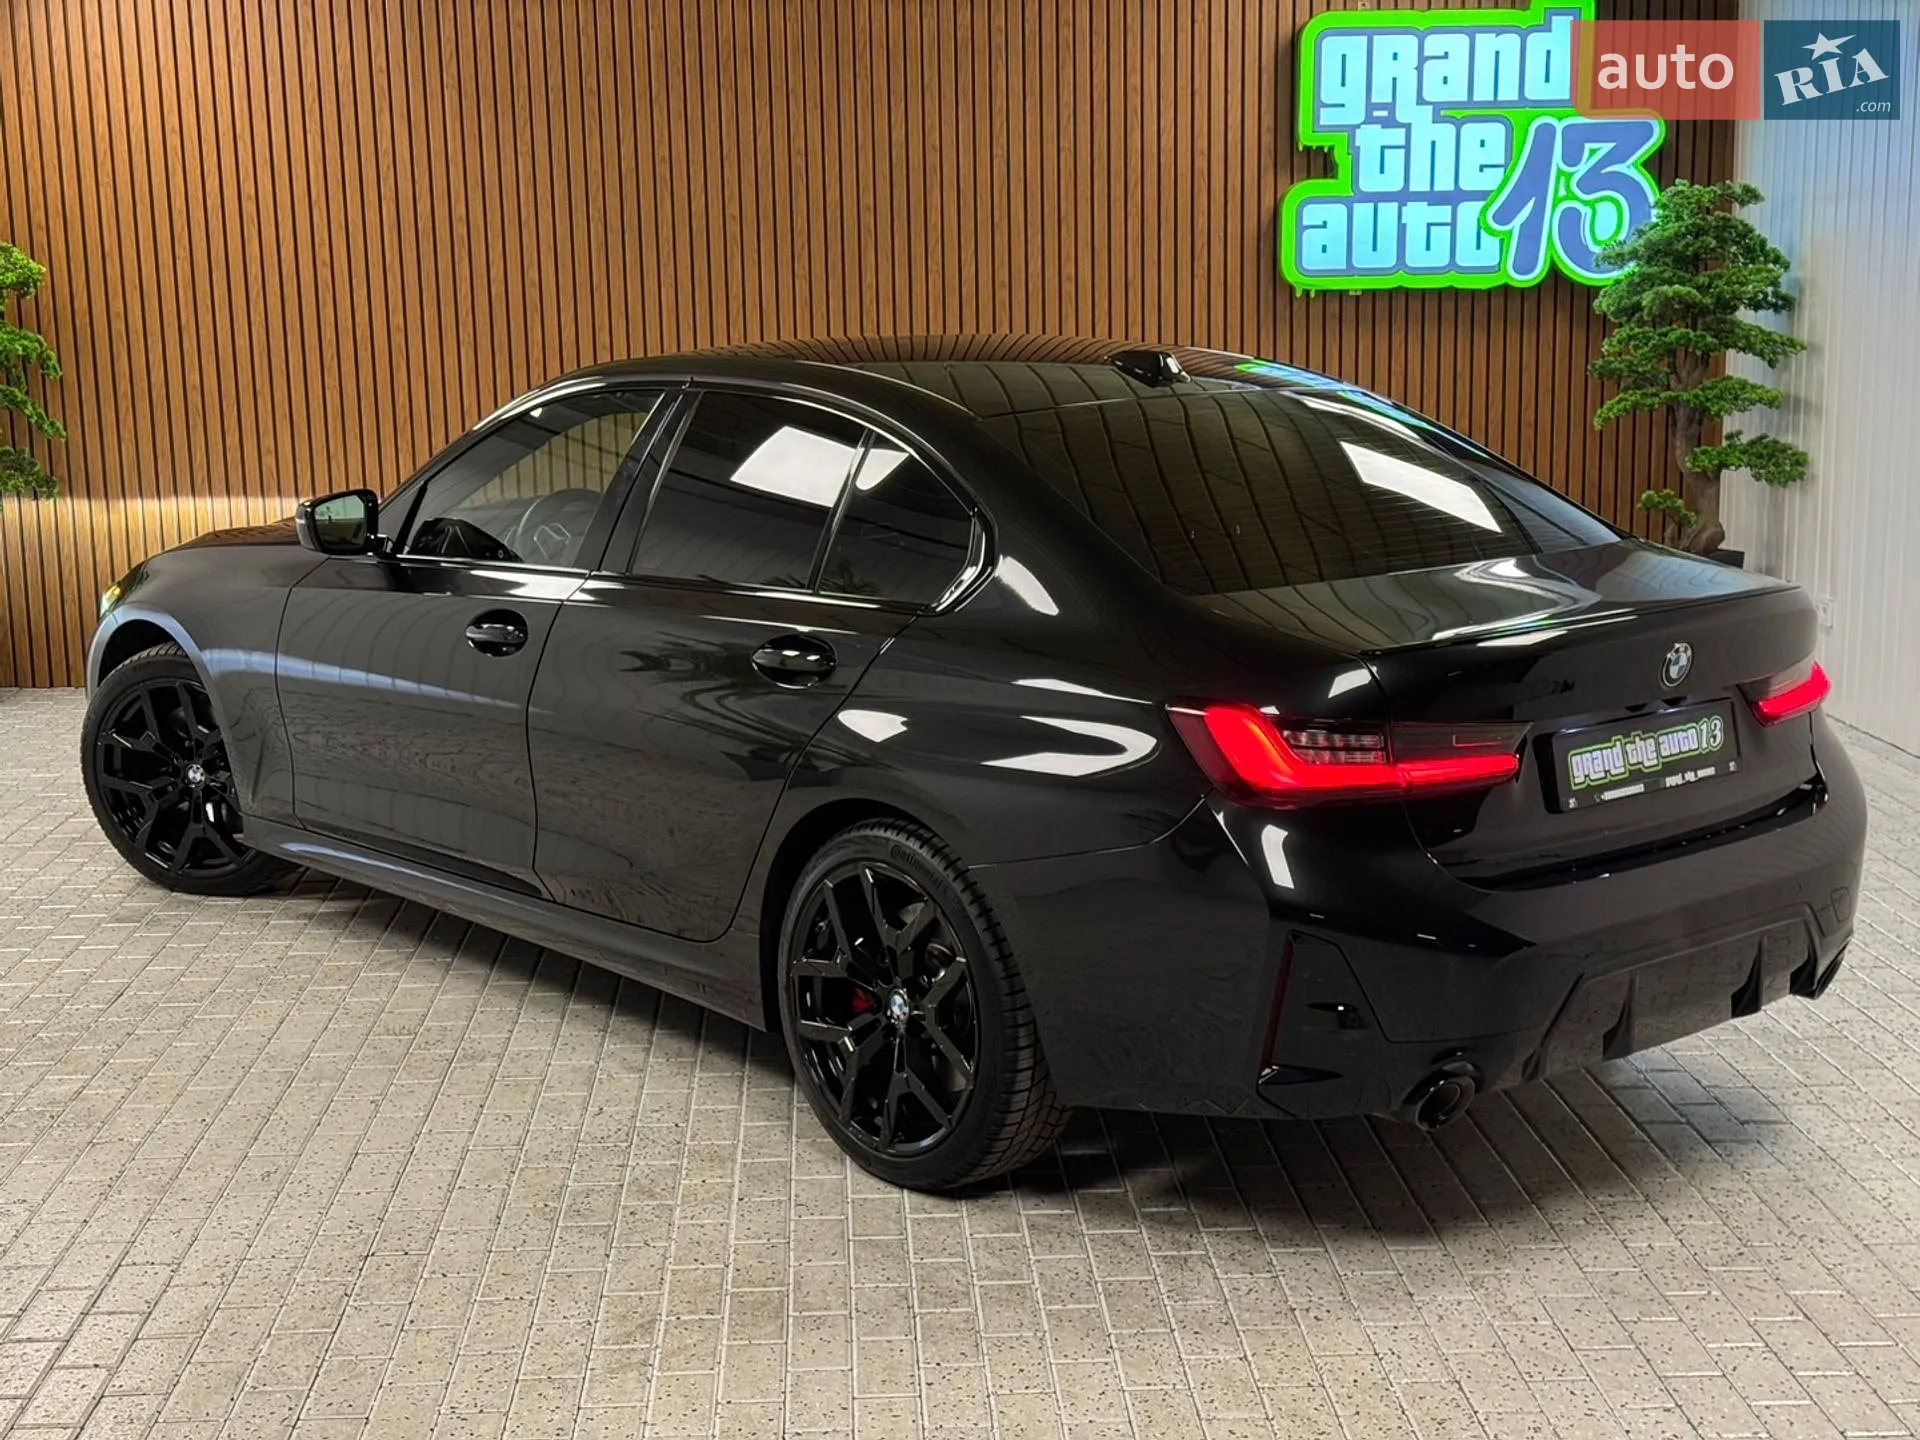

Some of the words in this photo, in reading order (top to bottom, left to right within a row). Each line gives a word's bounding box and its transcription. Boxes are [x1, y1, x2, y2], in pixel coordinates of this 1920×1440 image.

[1355, 104, 1506, 192] the
[1487, 117, 1660, 281] 13
[1698, 718, 1722, 750] 13
